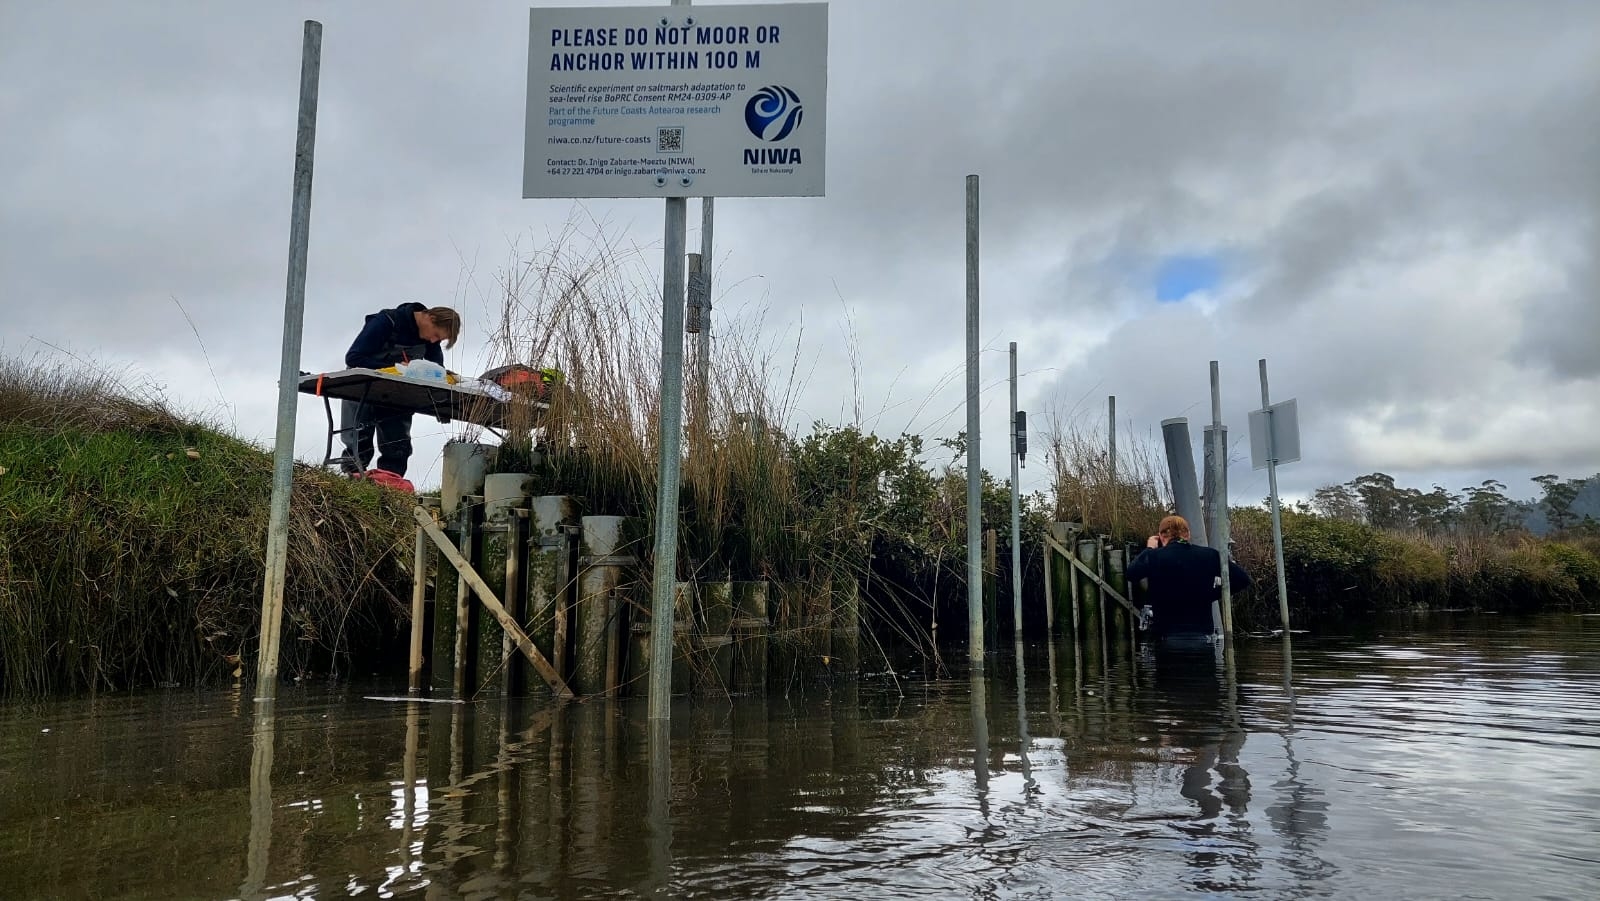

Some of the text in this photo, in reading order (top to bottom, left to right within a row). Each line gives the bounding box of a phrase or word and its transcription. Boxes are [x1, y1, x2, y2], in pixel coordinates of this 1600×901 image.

[551, 25, 780, 47] PLEASE DO NOT MOOR OR
[550, 50, 761, 71] ANCHOR WITHIN 100 M
[549, 84, 587, 93] Scientific
[588, 84, 634, 94] experiment
[648, 83, 689, 92] saltmarsh
[691, 82, 735, 92] adaptation
[737, 83, 746, 91] to
[549, 92, 732, 103] sea-level rise BoPRC Consent RM24-0309-AP
[549, 104, 721, 116] Part of the Future Coasts Aotearoa research
[548, 118, 595, 127] programme
[547, 135, 651, 145] niwa.co.nz/future-coasts
[547, 158, 577, 166] Contact:
[578, 158, 588, 166] Dr.
[668, 157, 695, 166] (NIWA)
[743, 148, 802, 165] NIWA
[547, 167, 561, 175] +64
[562, 167, 571, 175] 27
[572, 167, 584, 175] 221
[586, 167, 604, 175] 4704
